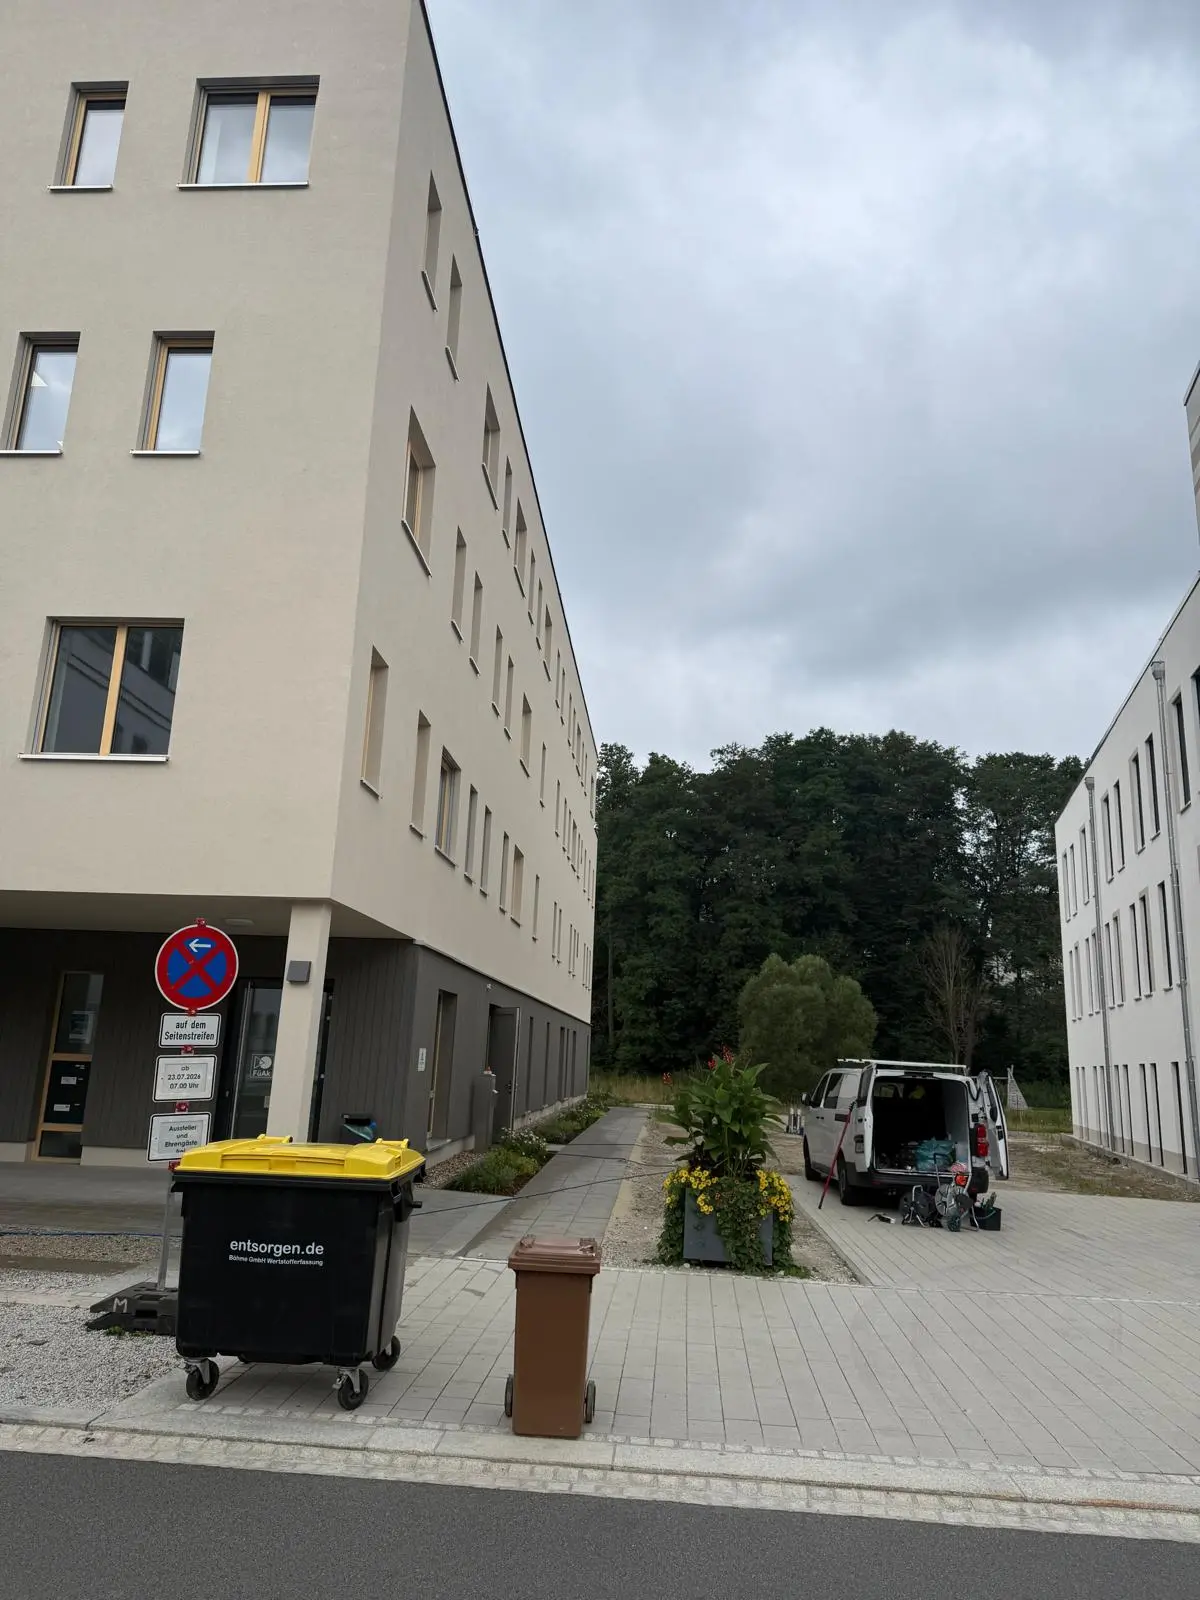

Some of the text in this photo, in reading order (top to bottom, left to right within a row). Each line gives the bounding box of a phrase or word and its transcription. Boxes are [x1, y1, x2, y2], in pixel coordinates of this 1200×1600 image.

[176, 1020, 206, 1028] auf dem
[164, 1032, 214, 1040] Seitenstreifen
[230, 1240, 324, 1257] entsorgen.de
